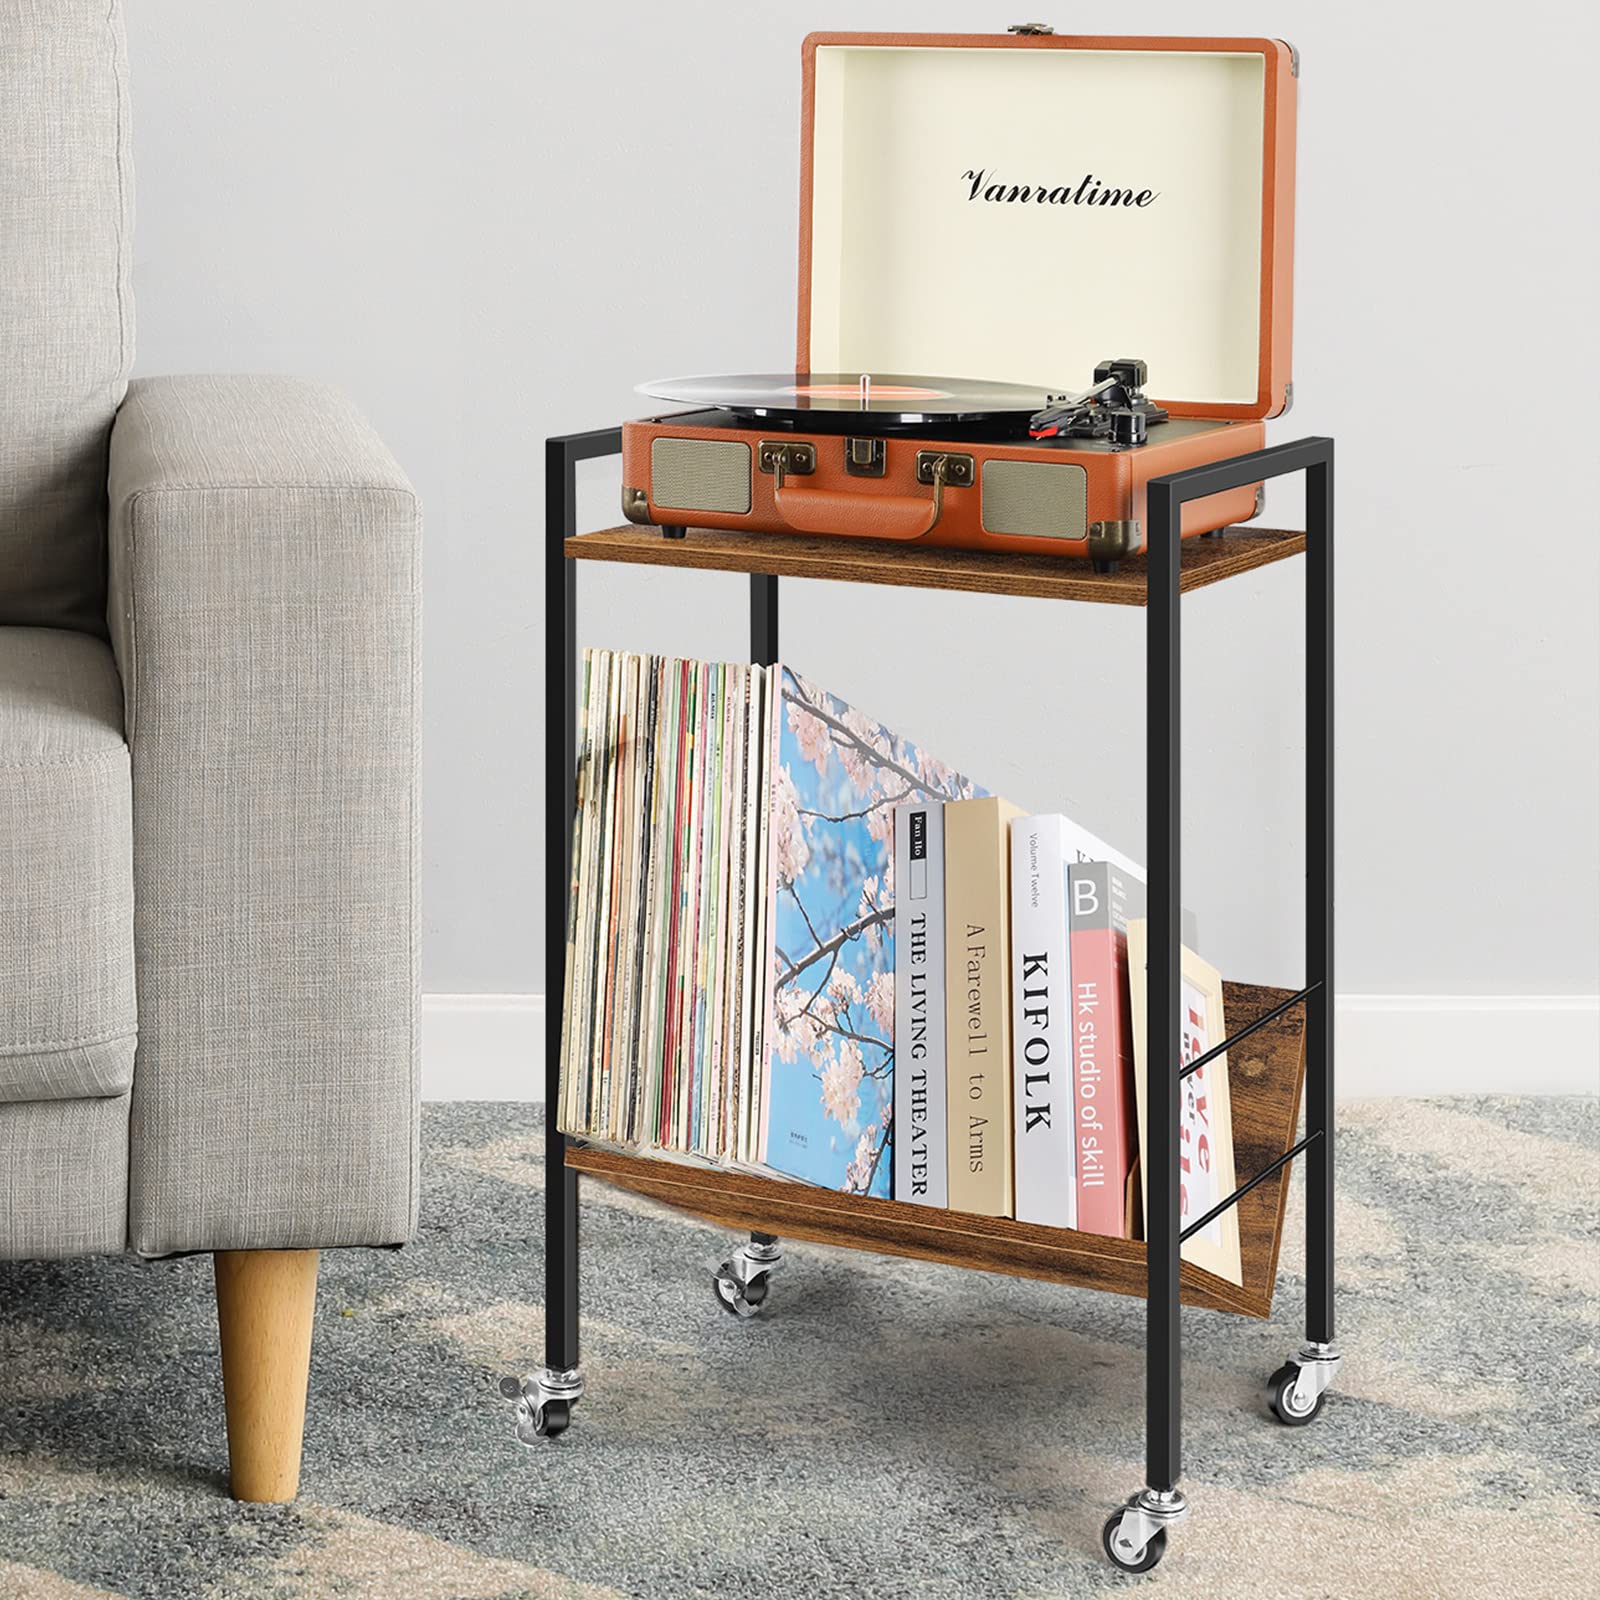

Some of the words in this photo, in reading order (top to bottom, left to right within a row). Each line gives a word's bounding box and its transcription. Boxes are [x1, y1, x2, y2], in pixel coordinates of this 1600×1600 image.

[961, 168, 1161, 208] Vanratime
[914, 816, 923, 838] Fan
[1029, 832, 1039, 871] Volume
[1031, 873, 1040, 908] Twelve
[1073, 879, 1099, 916] B
[911, 912, 927, 965] THE
[966, 924, 986, 938] A
[911, 973, 928, 1061] LIVING
[967, 945, 988, 1057] Farewell
[1077, 983, 1100, 1015] Hk
[1022, 952, 1052, 1134] KIFOLK
[1078, 1021, 1101, 1099] studio
[968, 1073, 985, 1101] to
[911, 1069, 928, 1197] THEATER
[1081, 1106, 1103, 1131] of
[969, 1115, 989, 1174] Arms
[1081, 1136, 1105, 1188] skill
